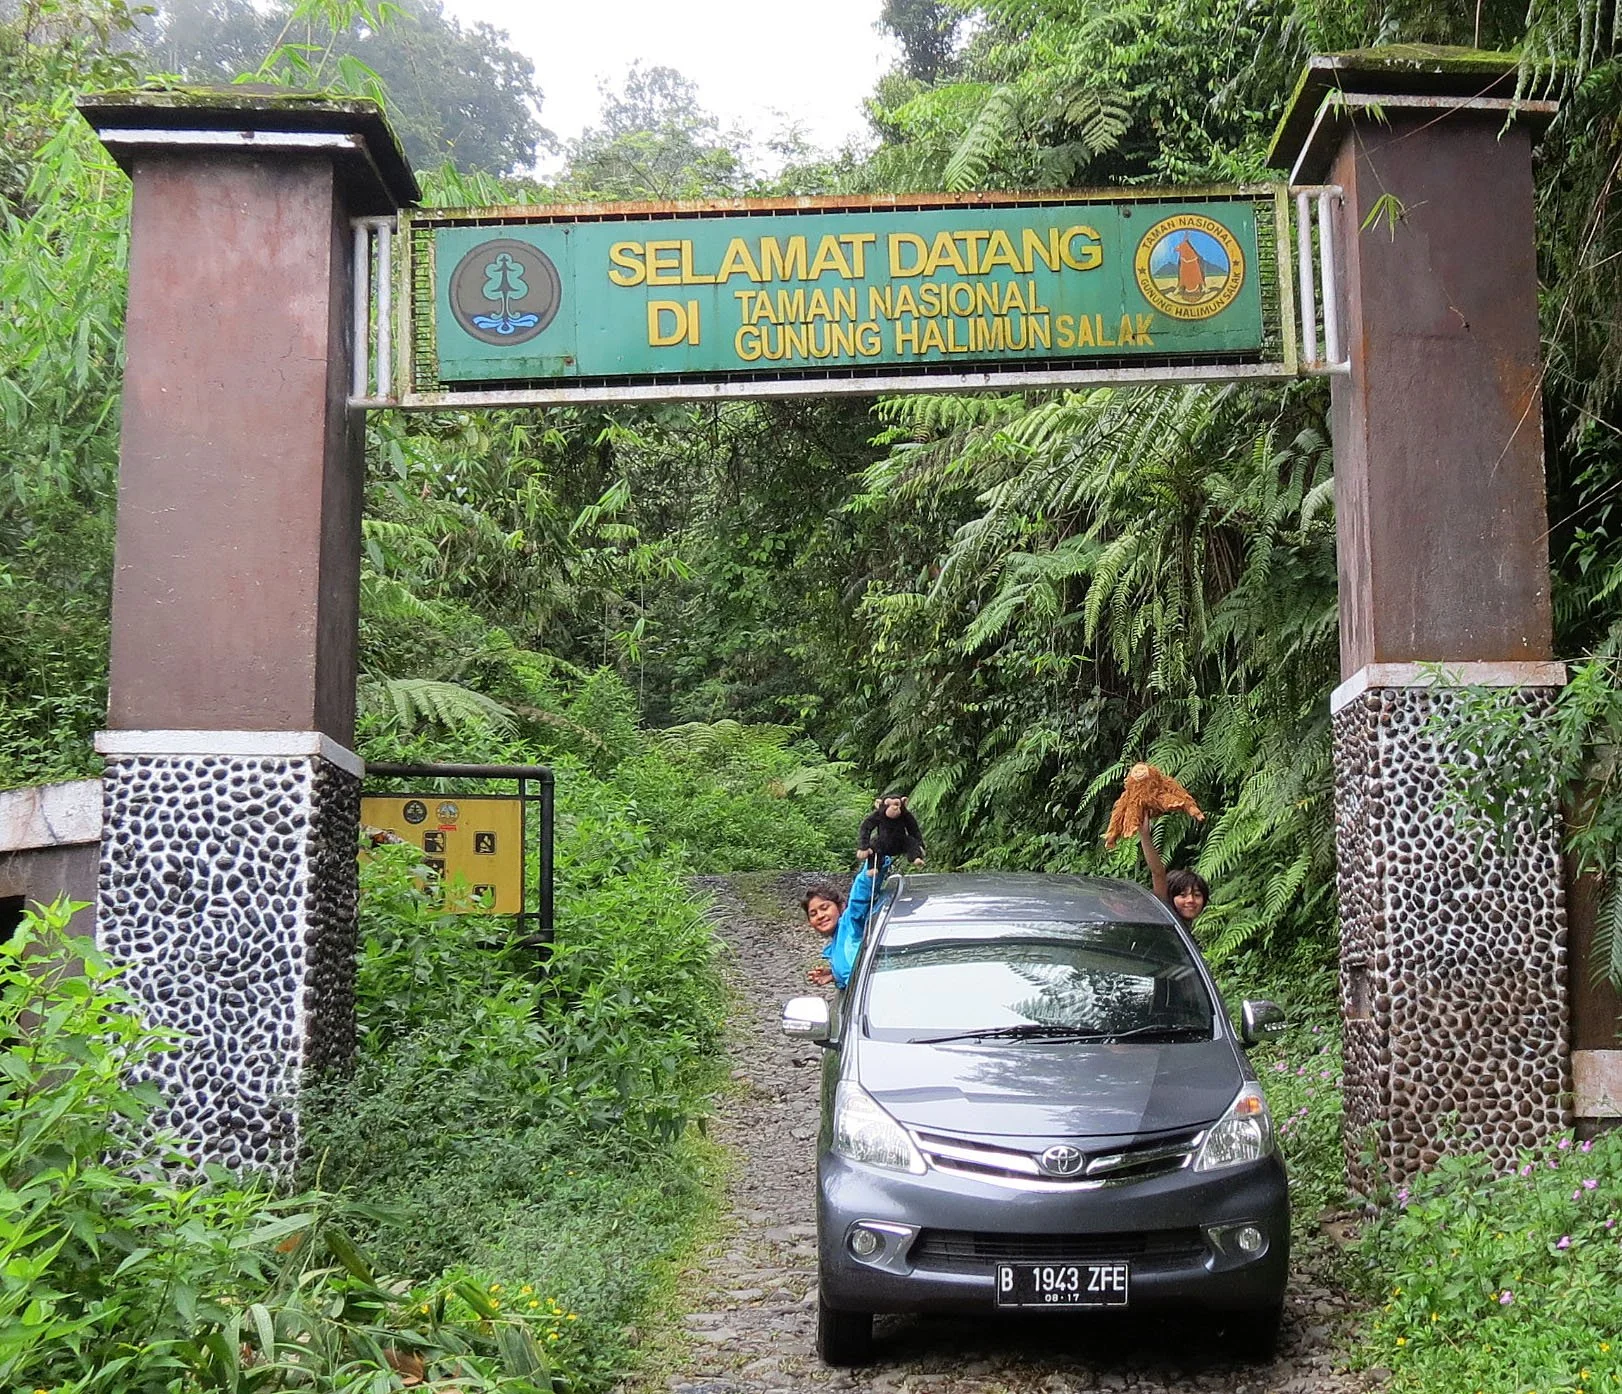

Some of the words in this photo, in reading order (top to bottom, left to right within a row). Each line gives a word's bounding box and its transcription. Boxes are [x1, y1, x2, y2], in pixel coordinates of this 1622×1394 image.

[608, 233, 876, 286] SELAMAT
[888, 225, 1102, 277] DATANG
[1142, 220, 1176, 250] TAMAN
[1178, 217, 1231, 247] NASIONAL
[734, 287, 857, 324] TAMAN
[868, 280, 1050, 320] NASIONAL
[1140, 278, 1173, 313] GUNUNG
[1174, 299, 1225, 317] HALIMUN
[1222, 271, 1242, 300] SALAK
[647, 300, 701, 347] DI
[734, 322, 882, 360] GUNUNG
[895, 316, 1053, 356] HALIMUN
[1056, 314, 1156, 349] SALAK
[1001, 1267, 1014, 1292] B
[1033, 1266, 1079, 1292] 1943
[1087, 1266, 1125, 1292] ZFE
